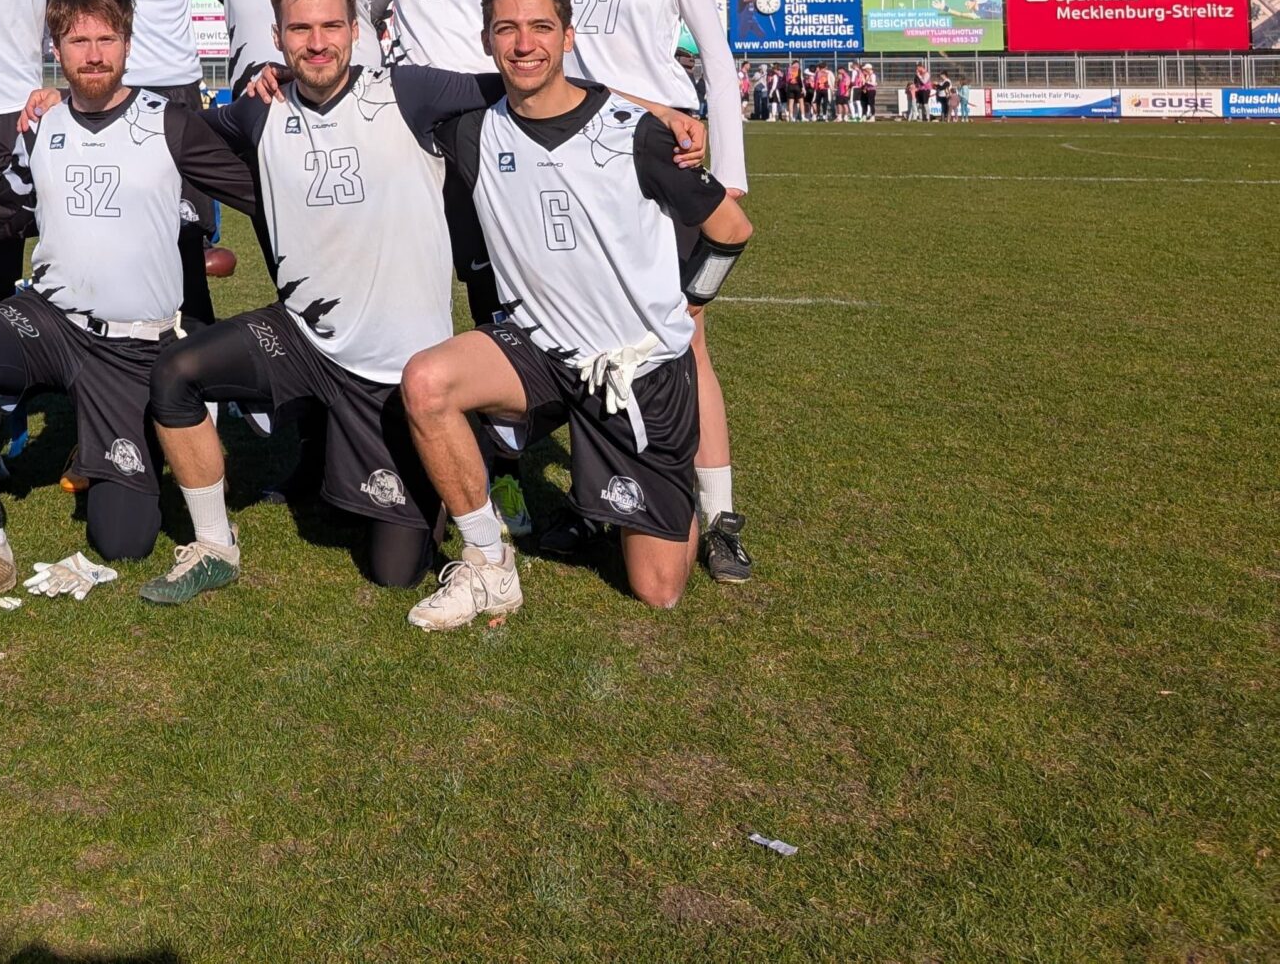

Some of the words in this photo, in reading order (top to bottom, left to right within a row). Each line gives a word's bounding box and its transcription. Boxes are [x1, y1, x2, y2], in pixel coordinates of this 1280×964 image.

[784, 3, 808, 14] FÜR
[1056, 3, 1235, 21] Mecklenburg-Strelitz
[784, 14, 849, 25] SCHIENEN-
[870, 18, 950, 29] BESICHTIGUNG!
[785, 25, 854, 36] FAHRZEUGE
[734, 39, 859, 50] www.omb-neustrelitz.de
[1151, 97, 1213, 108] GUSE
[305, 147, 365, 207] 23
[66, 164, 121, 218] 32
[540, 190, 577, 251] 6
